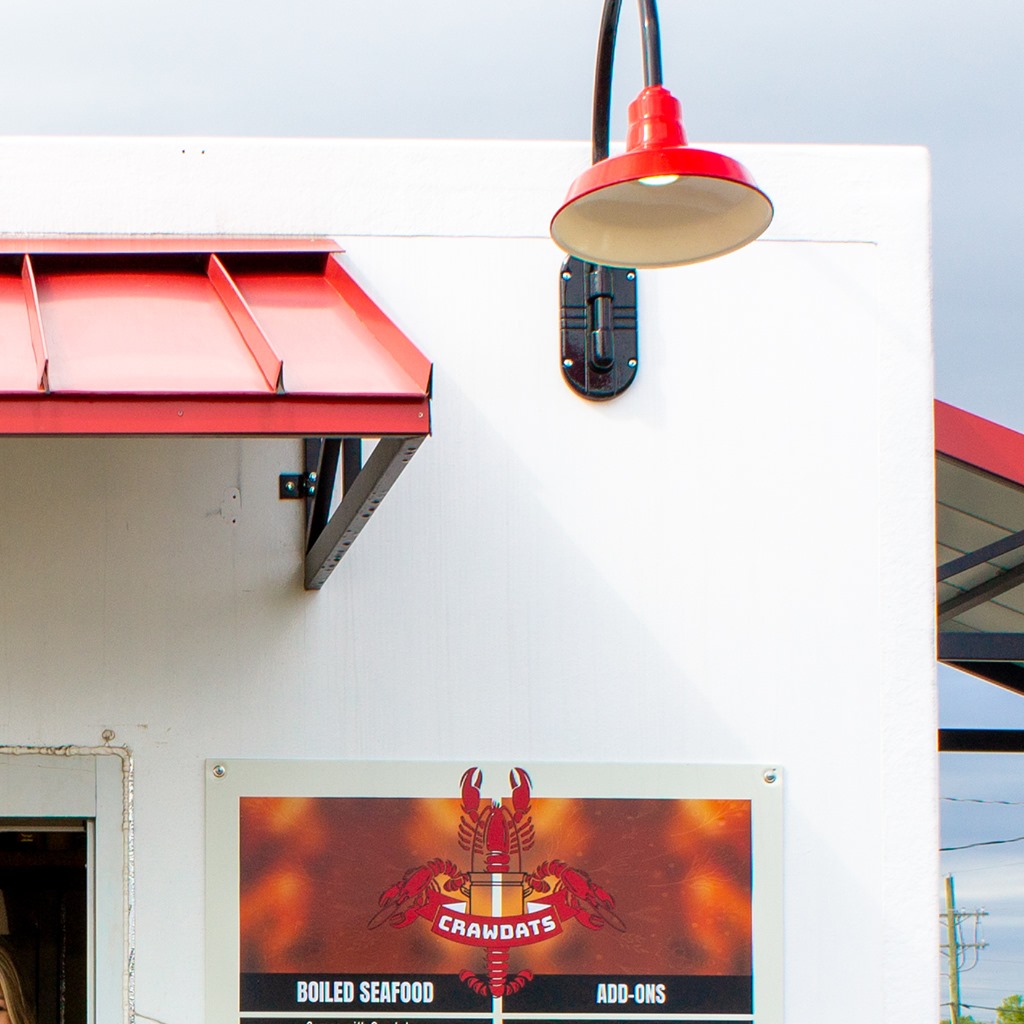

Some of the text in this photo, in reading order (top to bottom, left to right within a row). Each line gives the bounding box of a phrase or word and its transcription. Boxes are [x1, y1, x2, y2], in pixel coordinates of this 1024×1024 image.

[438, 915, 556, 940] CRAWDATS
[297, 981, 434, 1003] BOILED SEAFOOD
[596, 983, 666, 1004] ADD-ONS
